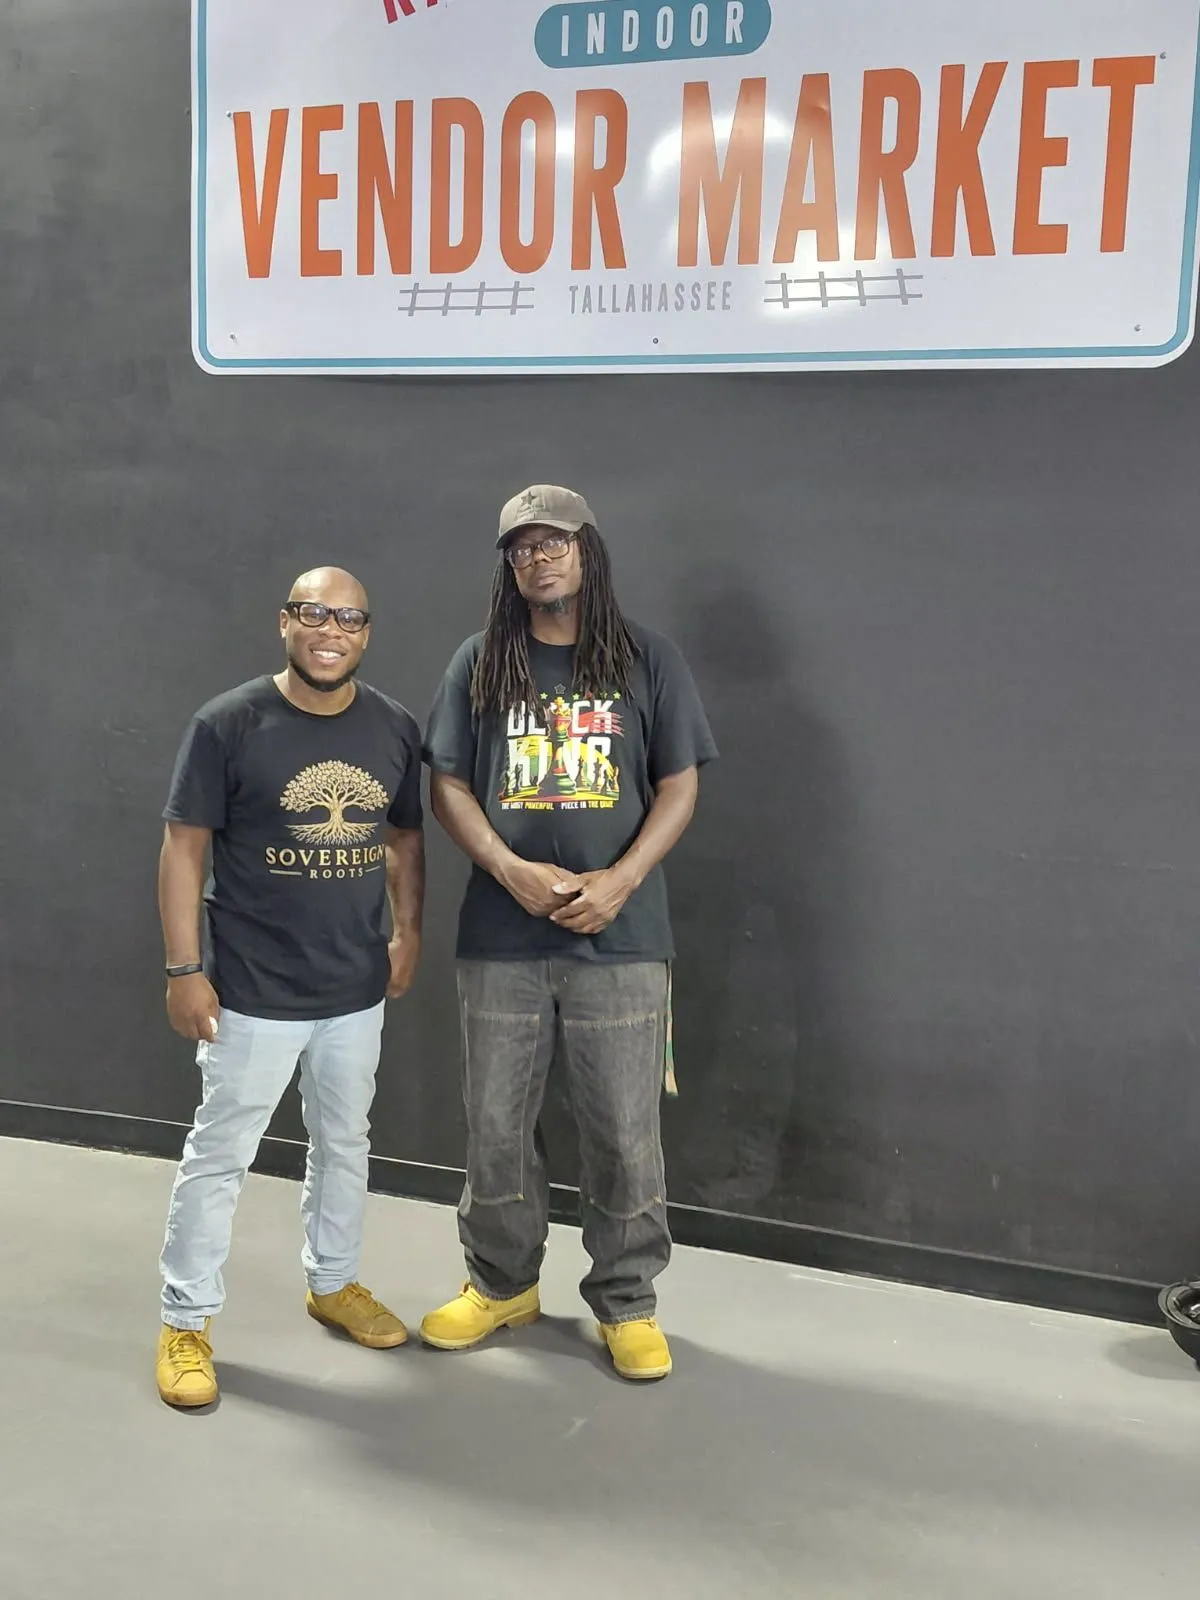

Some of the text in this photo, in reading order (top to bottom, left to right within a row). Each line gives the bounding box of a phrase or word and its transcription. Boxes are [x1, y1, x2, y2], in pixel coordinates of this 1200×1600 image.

[560, 1, 745, 57] INDOOR
[233, 55, 1156, 279] VENDOR MARKET
[568, 280, 733, 314] TALLAHASSEE
[506, 700, 614, 736] BLCK
[265, 844, 385, 866] SOVEREIGN
[309, 867, 364, 879] ROOTS
